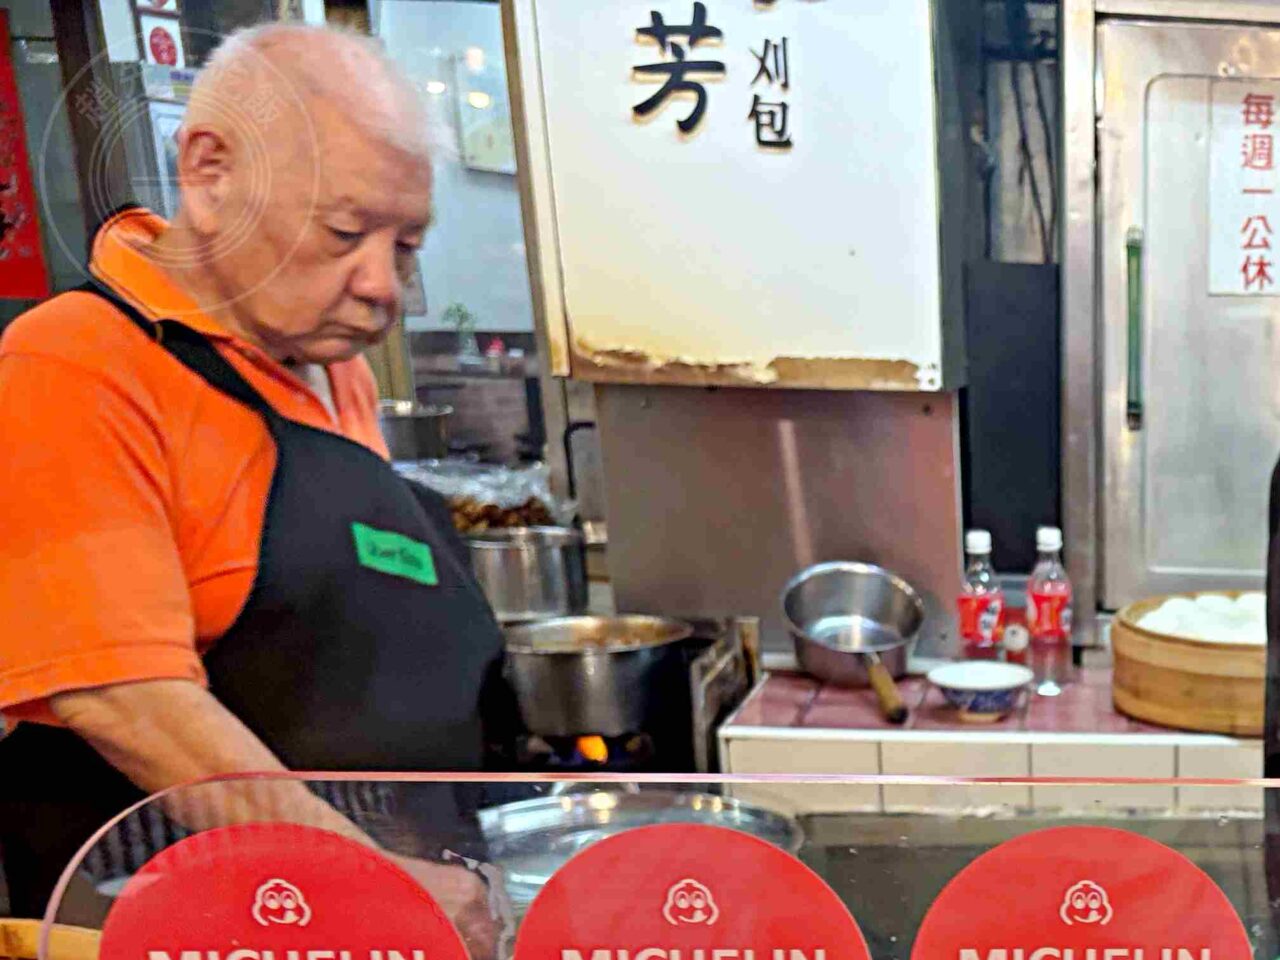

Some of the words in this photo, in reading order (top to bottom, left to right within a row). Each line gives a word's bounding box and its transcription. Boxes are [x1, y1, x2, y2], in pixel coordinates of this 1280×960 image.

[632, 2, 726, 134] 芳
[749, 36, 793, 150] 刈包
[1240, 92, 1276, 291] 每週一公休
